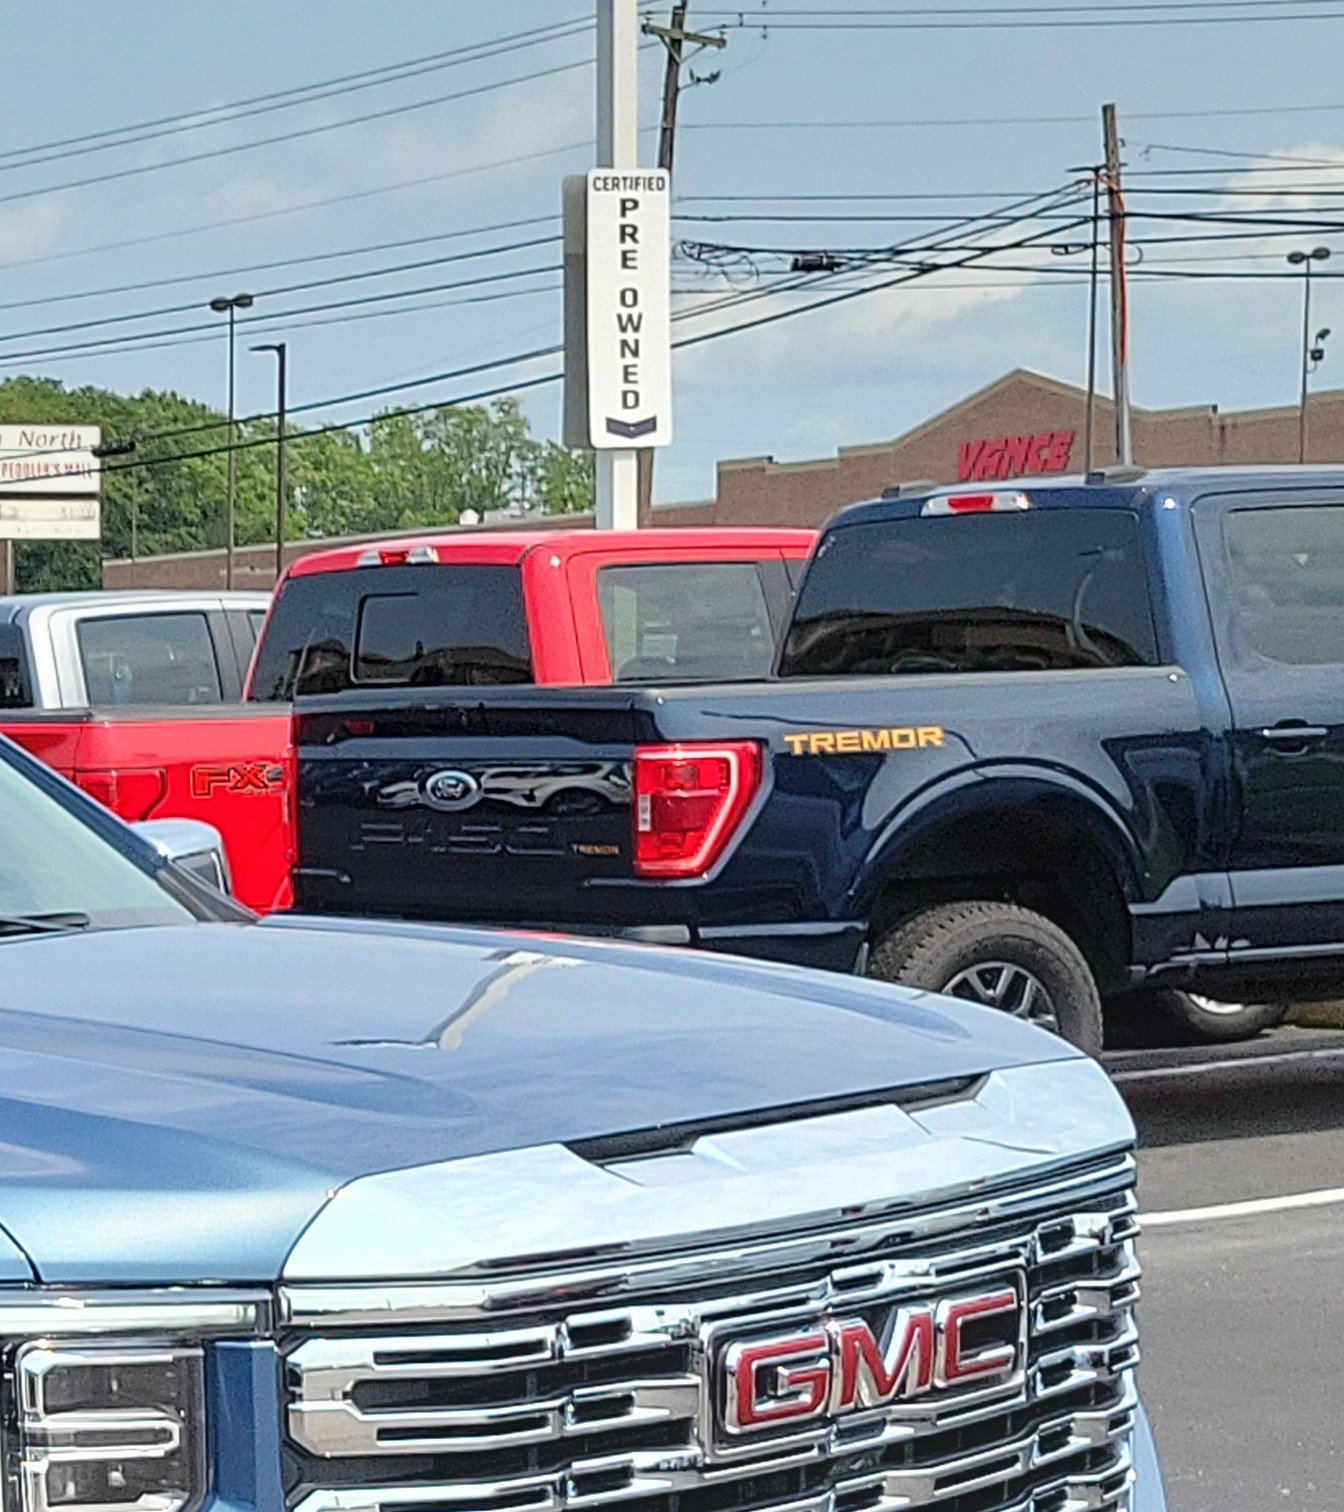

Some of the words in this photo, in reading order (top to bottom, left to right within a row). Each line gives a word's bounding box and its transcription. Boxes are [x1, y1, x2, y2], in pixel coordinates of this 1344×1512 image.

[592, 176, 666, 192] CERTIFIED
[619, 198, 640, 270] PRE
[616, 287, 643, 410] OWNED
[18, 429, 82, 448] North
[957, 430, 1075, 481] VANCE
[783, 726, 944, 757] TREMOR
[725, 1287, 1018, 1435] GMC
